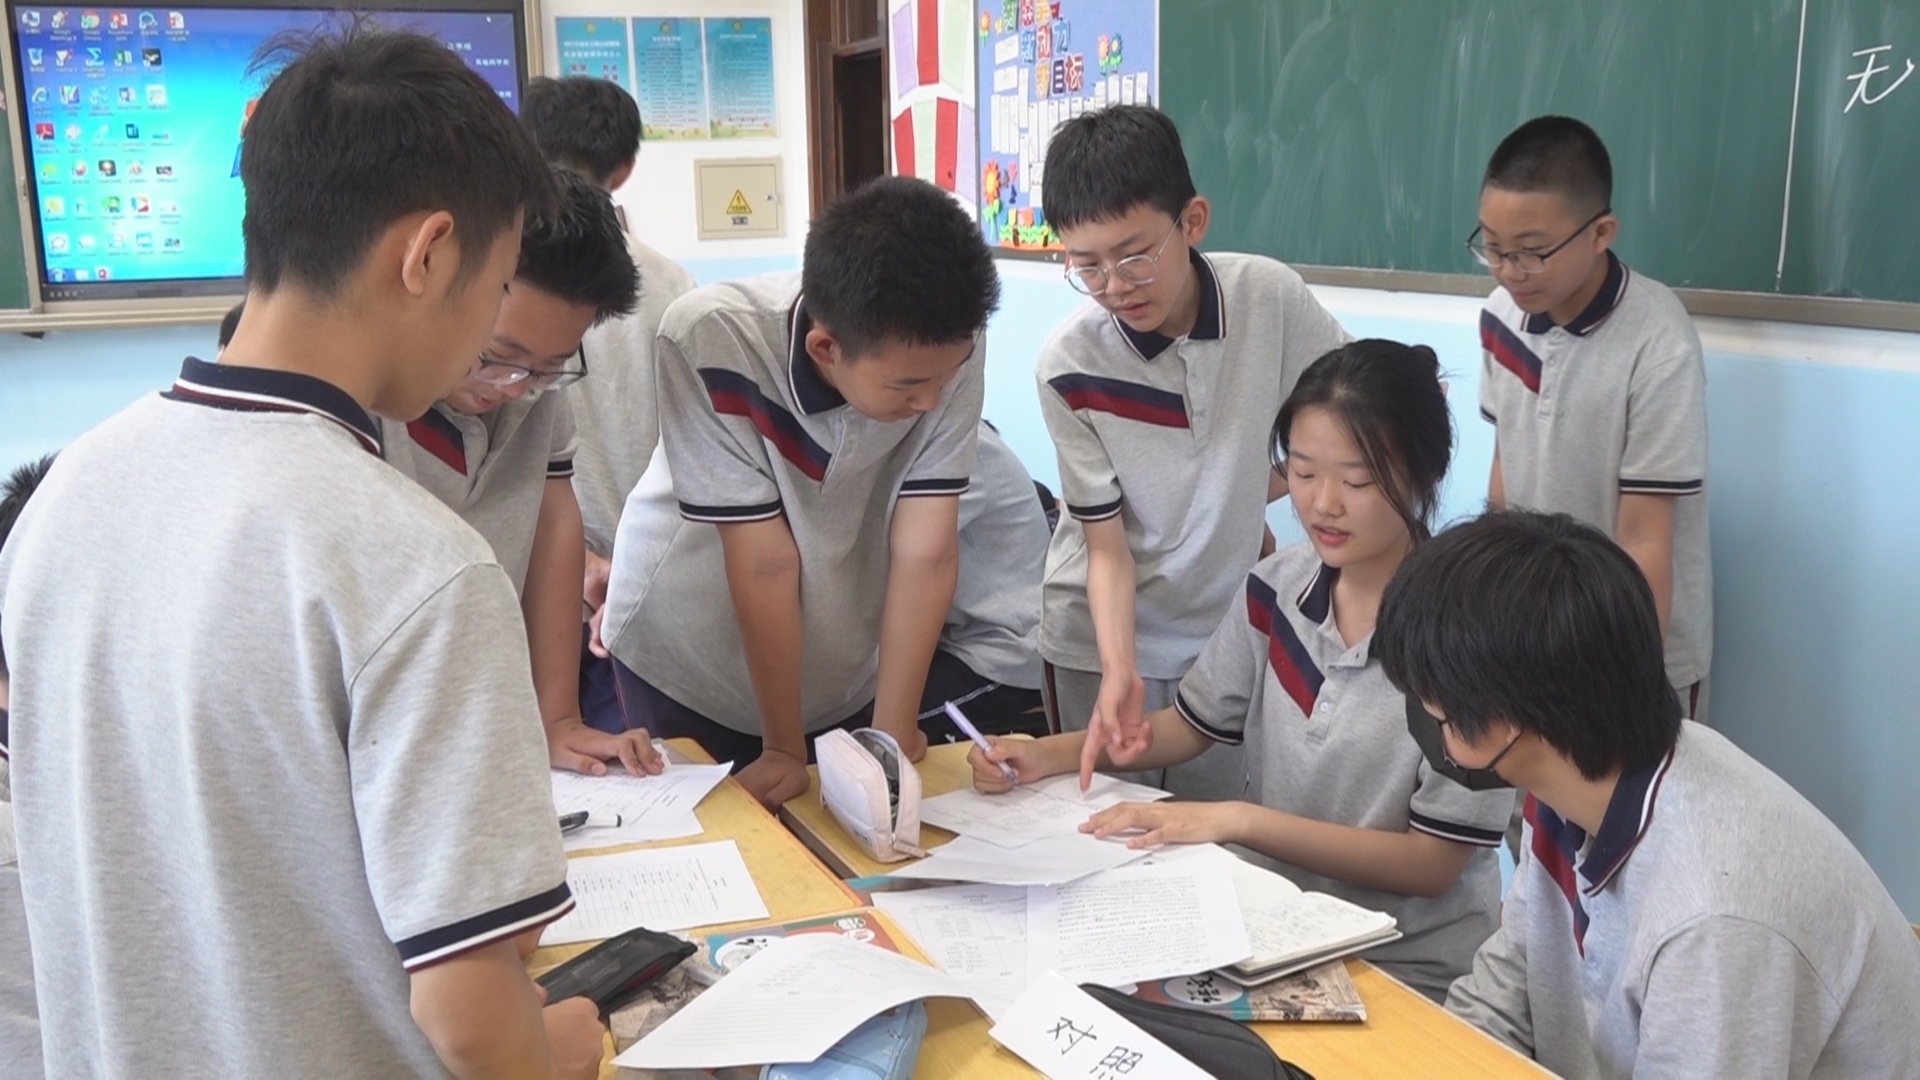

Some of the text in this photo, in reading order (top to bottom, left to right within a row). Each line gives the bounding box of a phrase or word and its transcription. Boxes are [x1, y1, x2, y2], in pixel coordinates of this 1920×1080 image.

[1036, 54, 1084, 98] 新目标
[1845, 45, 1915, 113] 无
[1046, 1016, 1143, 1080] 对照
